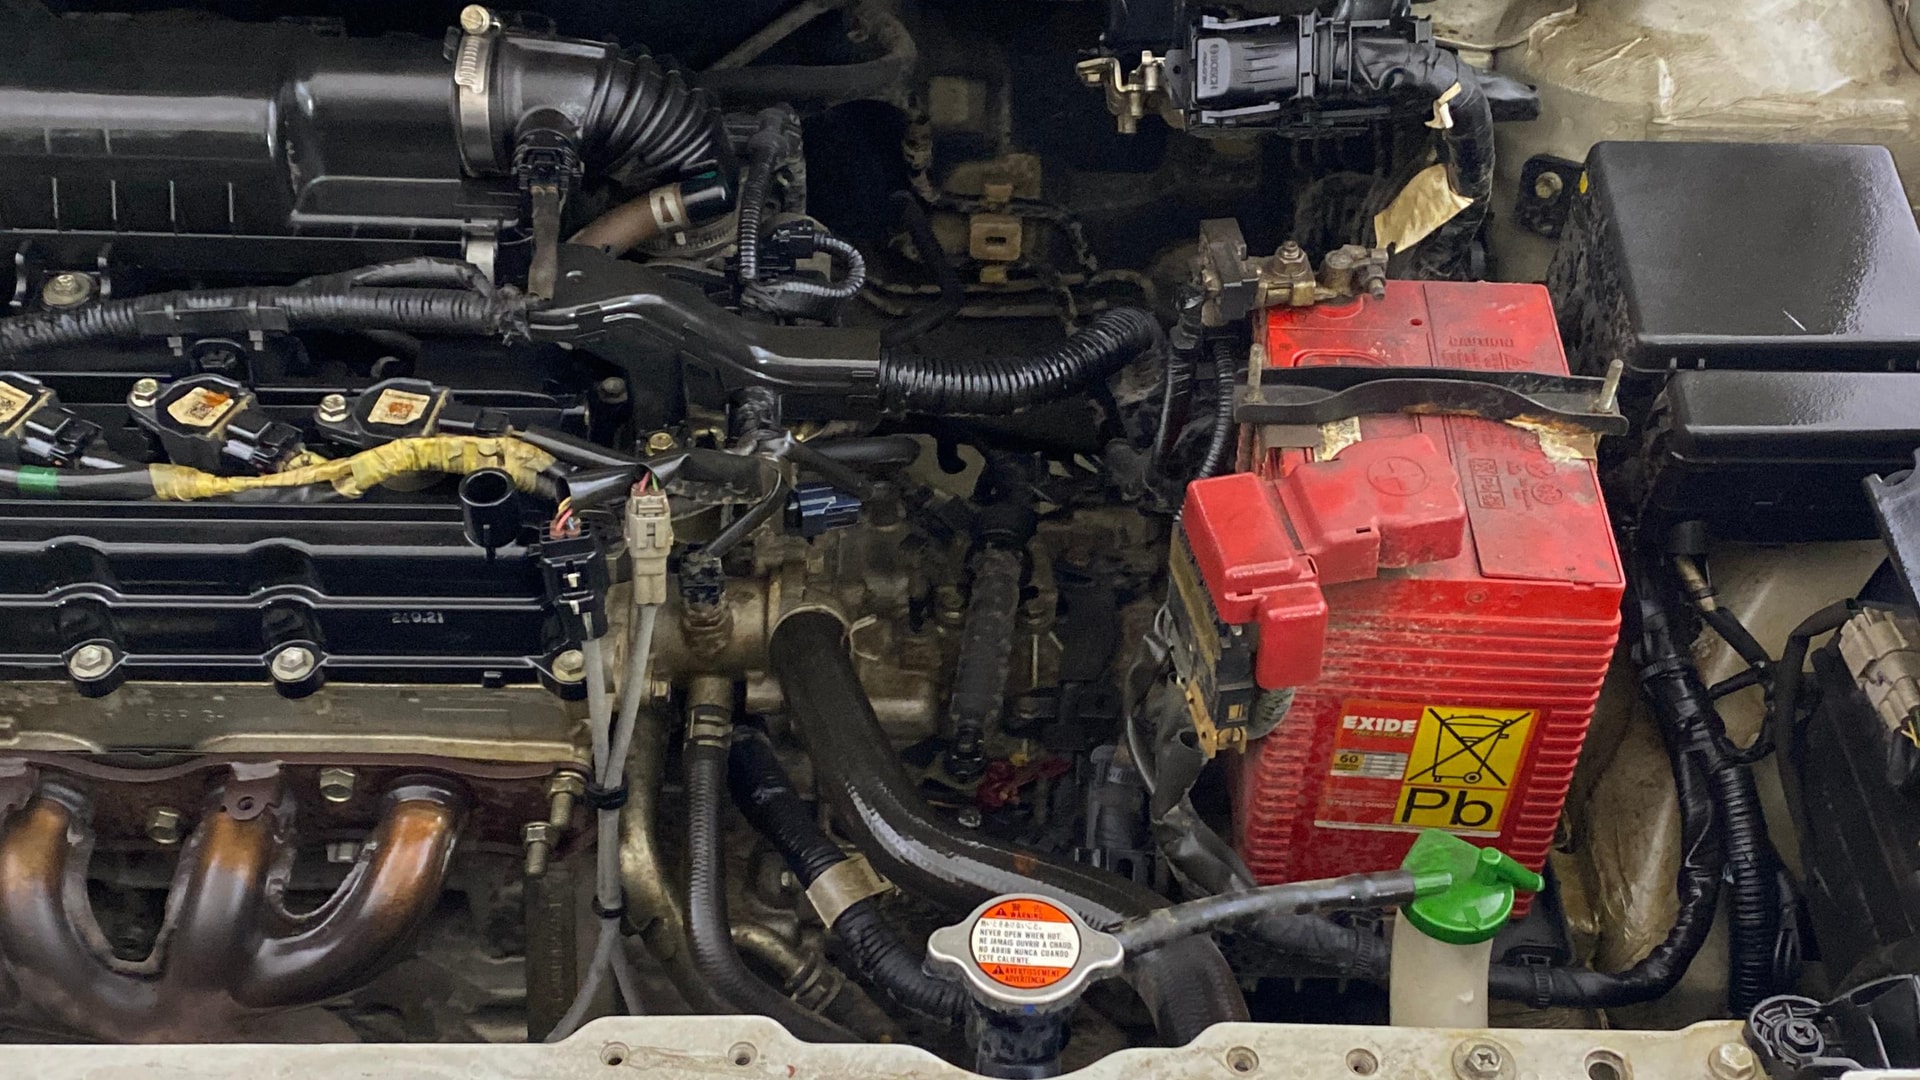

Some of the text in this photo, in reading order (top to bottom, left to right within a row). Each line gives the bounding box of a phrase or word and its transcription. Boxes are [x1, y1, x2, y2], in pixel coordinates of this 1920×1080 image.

[1342, 715, 1418, 733] EXIDE
[1339, 752, 1359, 764] 60
[1401, 787, 1493, 827] Pb
[1010, 911, 1042, 920] WARNIN
[980, 929, 1001, 937] NEVER
[1004, 930, 1022, 939] OPEN
[1025, 931, 1045, 940] WHEN
[979, 937, 987, 945] NE
[990, 938, 1014, 947] JAMAIS
[1016, 939, 1040, 948] OUVRIR
[991, 947, 1011, 955] ABRIR
[1014, 948, 1038, 957] NUNCA
[1040, 949, 1069, 958] CUANDO
[1005, 967, 1060, 977] AVERTISSEMENT
